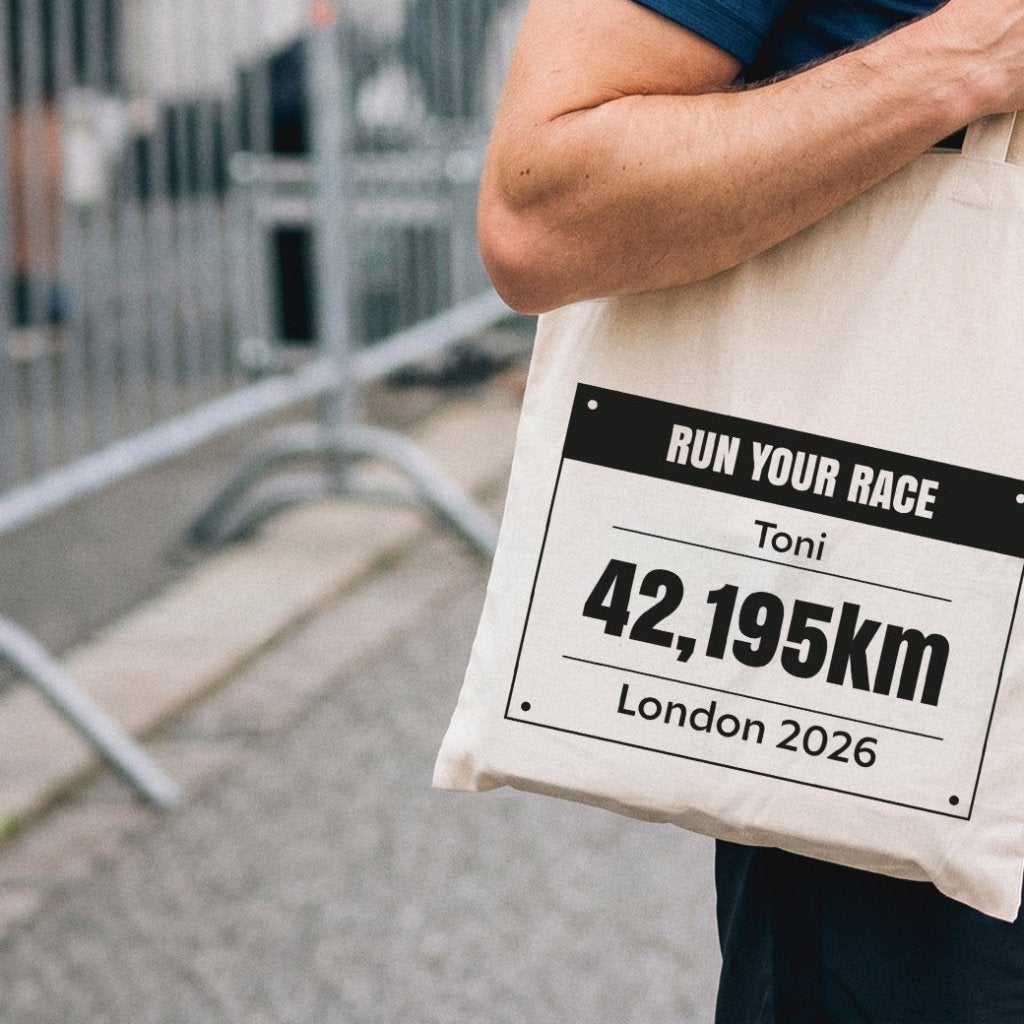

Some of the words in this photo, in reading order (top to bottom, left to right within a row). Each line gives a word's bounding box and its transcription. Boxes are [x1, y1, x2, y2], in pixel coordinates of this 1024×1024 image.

[666, 424, 741, 476] RUN
[750, 442, 840, 498] YOUR
[847, 466, 940, 519] RACE
[754, 520, 827, 561] Toni
[582, 558, 950, 707] 42,195km
[617, 684, 765, 744] London
[776, 719, 878, 768] 2026
